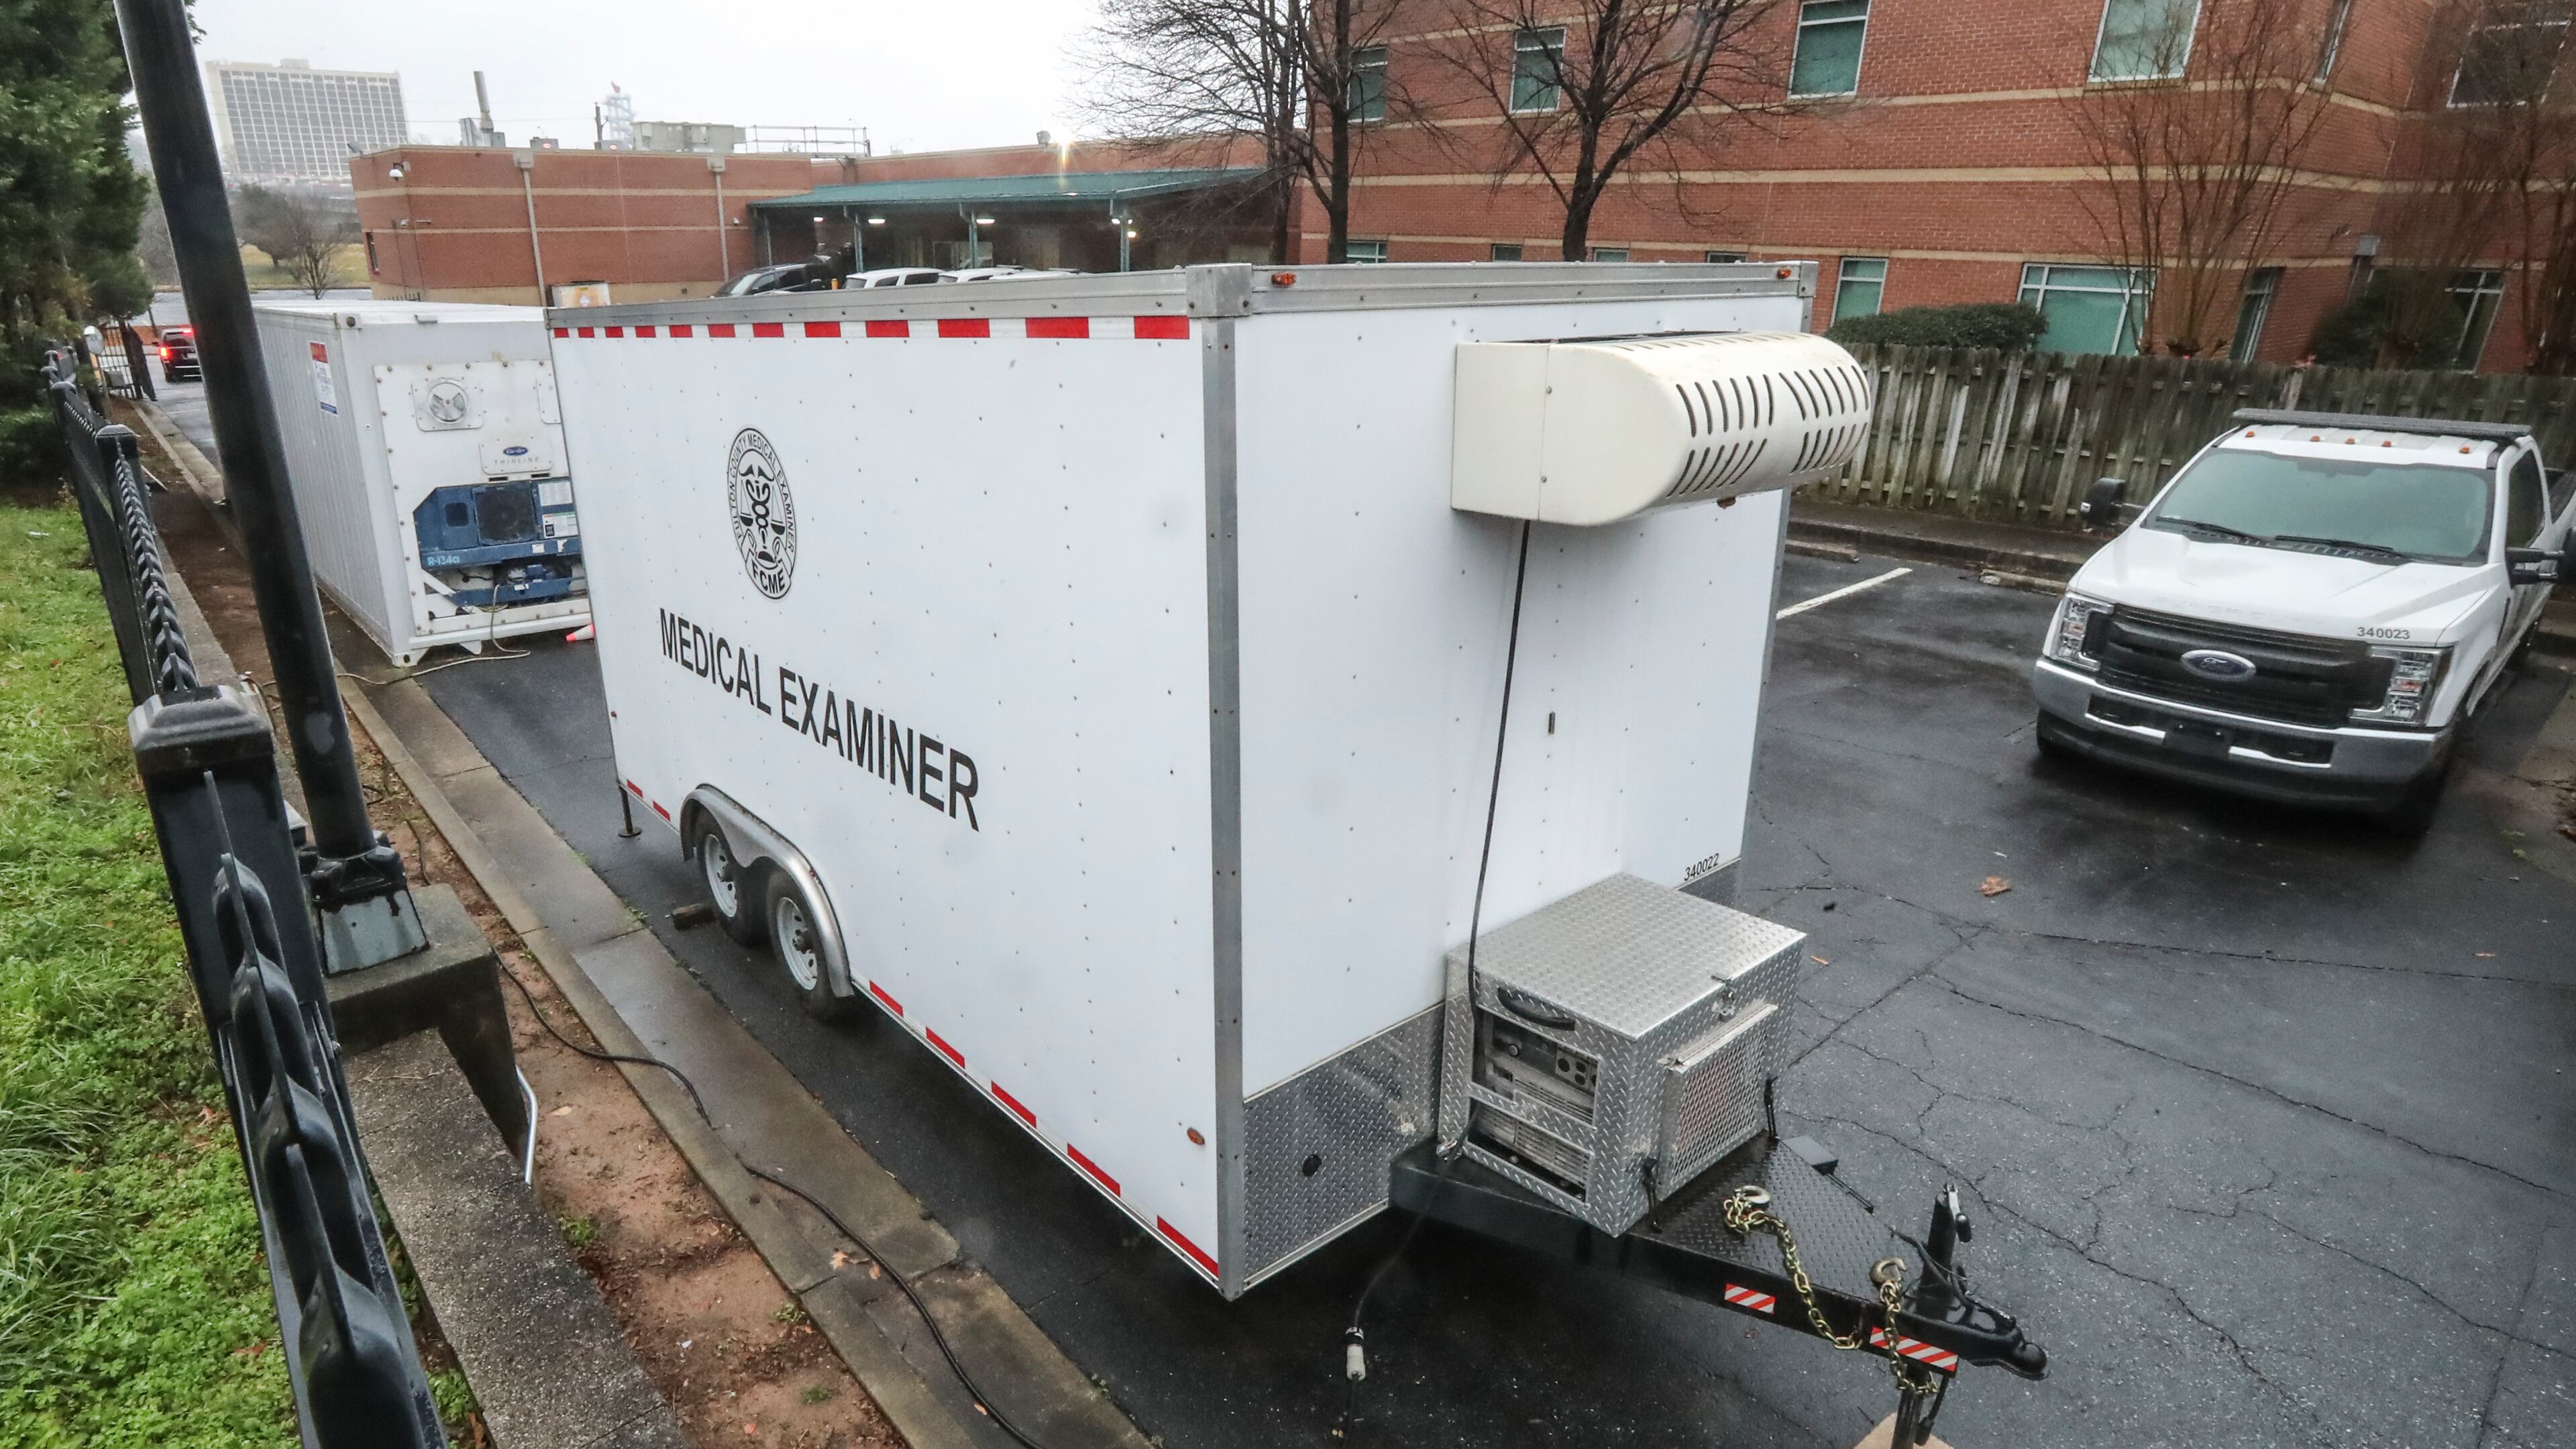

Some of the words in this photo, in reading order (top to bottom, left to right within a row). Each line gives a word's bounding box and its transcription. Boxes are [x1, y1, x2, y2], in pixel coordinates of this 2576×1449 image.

[730, 437, 747, 478] COUNTY
[747, 433, 776, 471] MEDICAL
[776, 470, 794, 553] EXAMINER
[427, 555, 460, 566] R-134a
[752, 559, 786, 594] FCME
[2357, 627, 2410, 639] 340023
[659, 607, 771, 716] MEDICAL
[779, 665, 979, 832] EXAMINER
[1684, 853, 1719, 881] 340022
